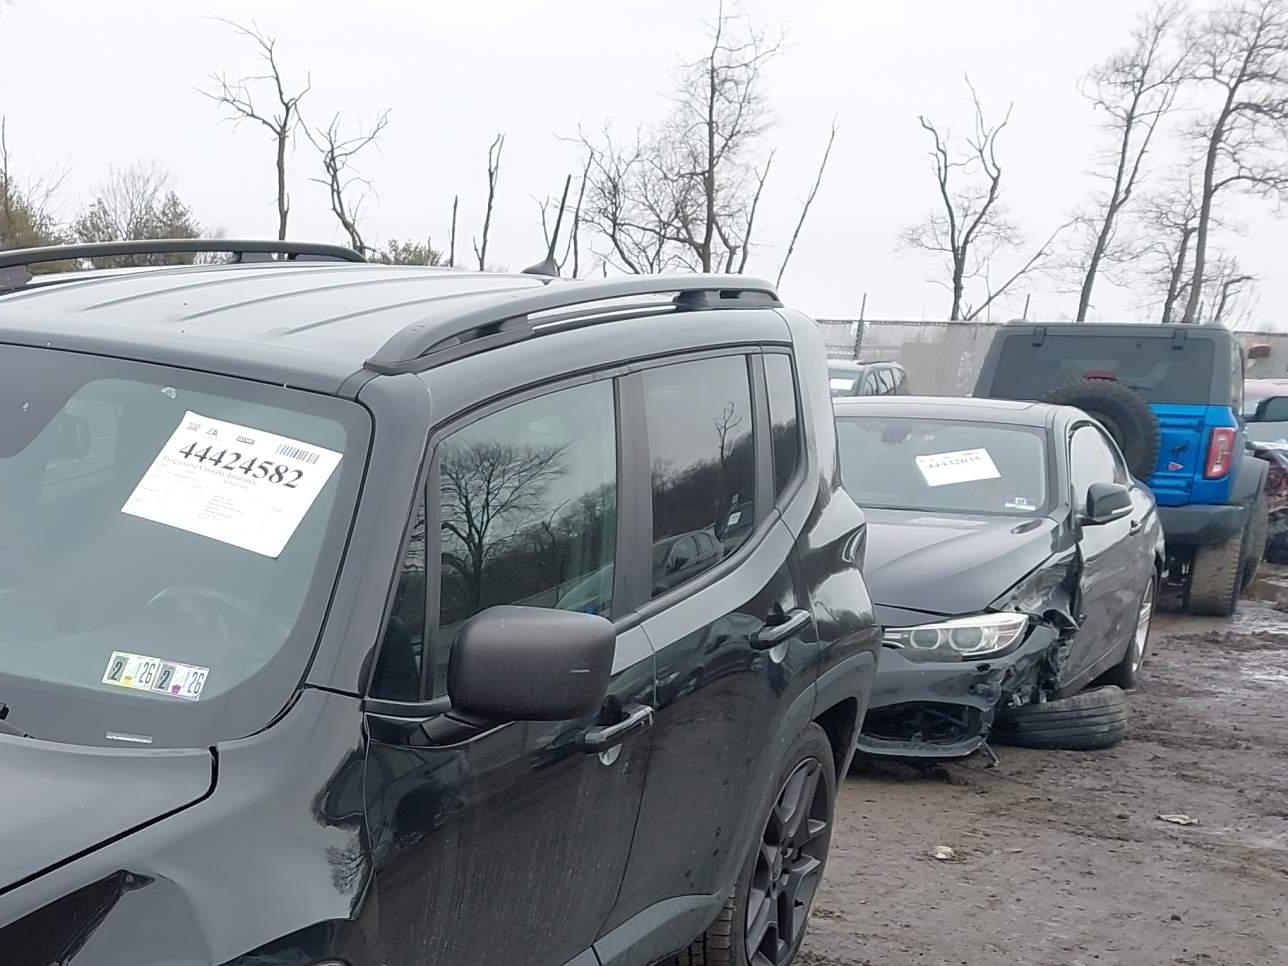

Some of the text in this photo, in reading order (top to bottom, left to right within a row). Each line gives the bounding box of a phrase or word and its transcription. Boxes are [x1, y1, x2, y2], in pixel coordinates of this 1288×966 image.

[179, 441, 304, 489] 44424582
[110, 660, 156, 685] 2 26
[157, 669, 205, 695] 2 26
